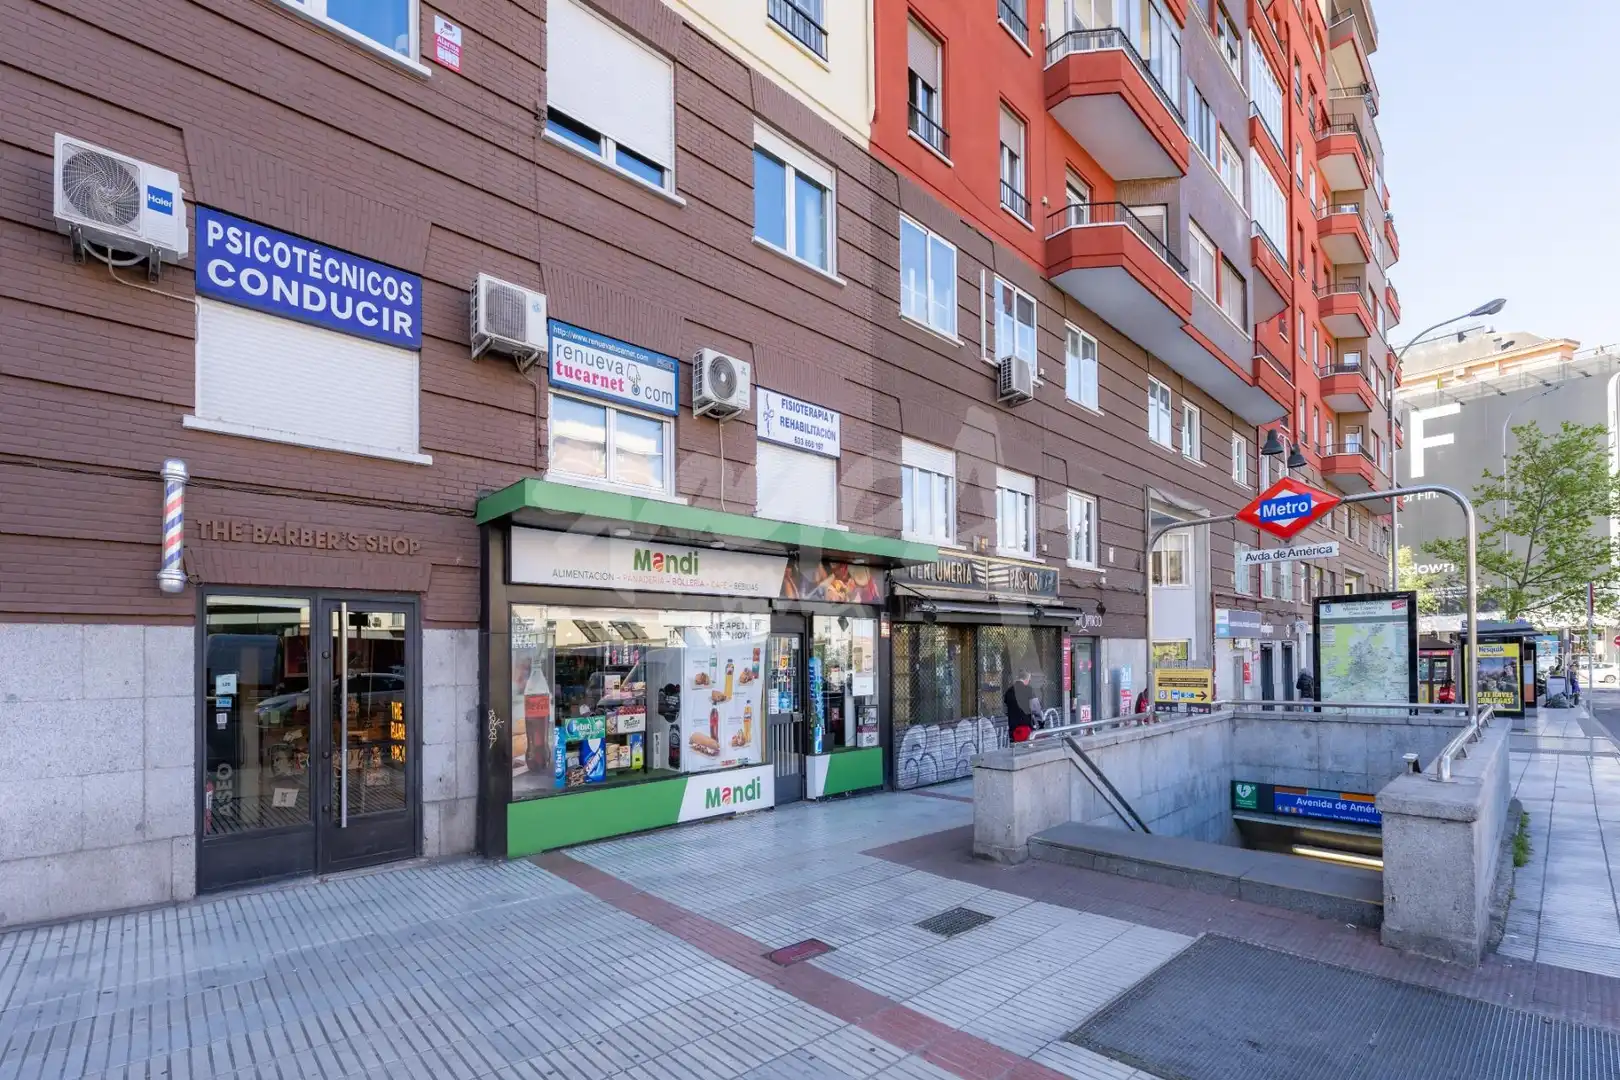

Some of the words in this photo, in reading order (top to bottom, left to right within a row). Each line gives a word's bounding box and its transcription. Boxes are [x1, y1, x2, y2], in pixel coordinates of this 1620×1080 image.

[148, 190, 173, 208] Haier
[207, 219, 413, 306] PSICOTÉCNICOS
[207, 258, 413, 338] CONDUCIR
[556, 343, 624, 376] renueva
[555, 360, 624, 393] tucarnet
[645, 385, 673, 405] com
[781, 397, 829, 421] FISIOTERAPIA
[829, 413, 834, 424] Y
[780, 416, 836, 441] REHABILITACIÓN
[1409, 403, 1461, 478] F
[1262, 501, 1309, 518] Metro
[198, 519, 244, 542] THE
[252, 523, 359, 551] BARBER'S
[365, 535, 422, 555] SHOP
[1273, 549, 1287, 559] de
[1287, 544, 1333, 558] América
[633, 547, 700, 576] Mandi
[215, 762, 233, 817] ASEO
[705, 776, 760, 809] Mandi
[1296, 797, 1333, 809] Avenida
[1335, 800, 1348, 811] de
